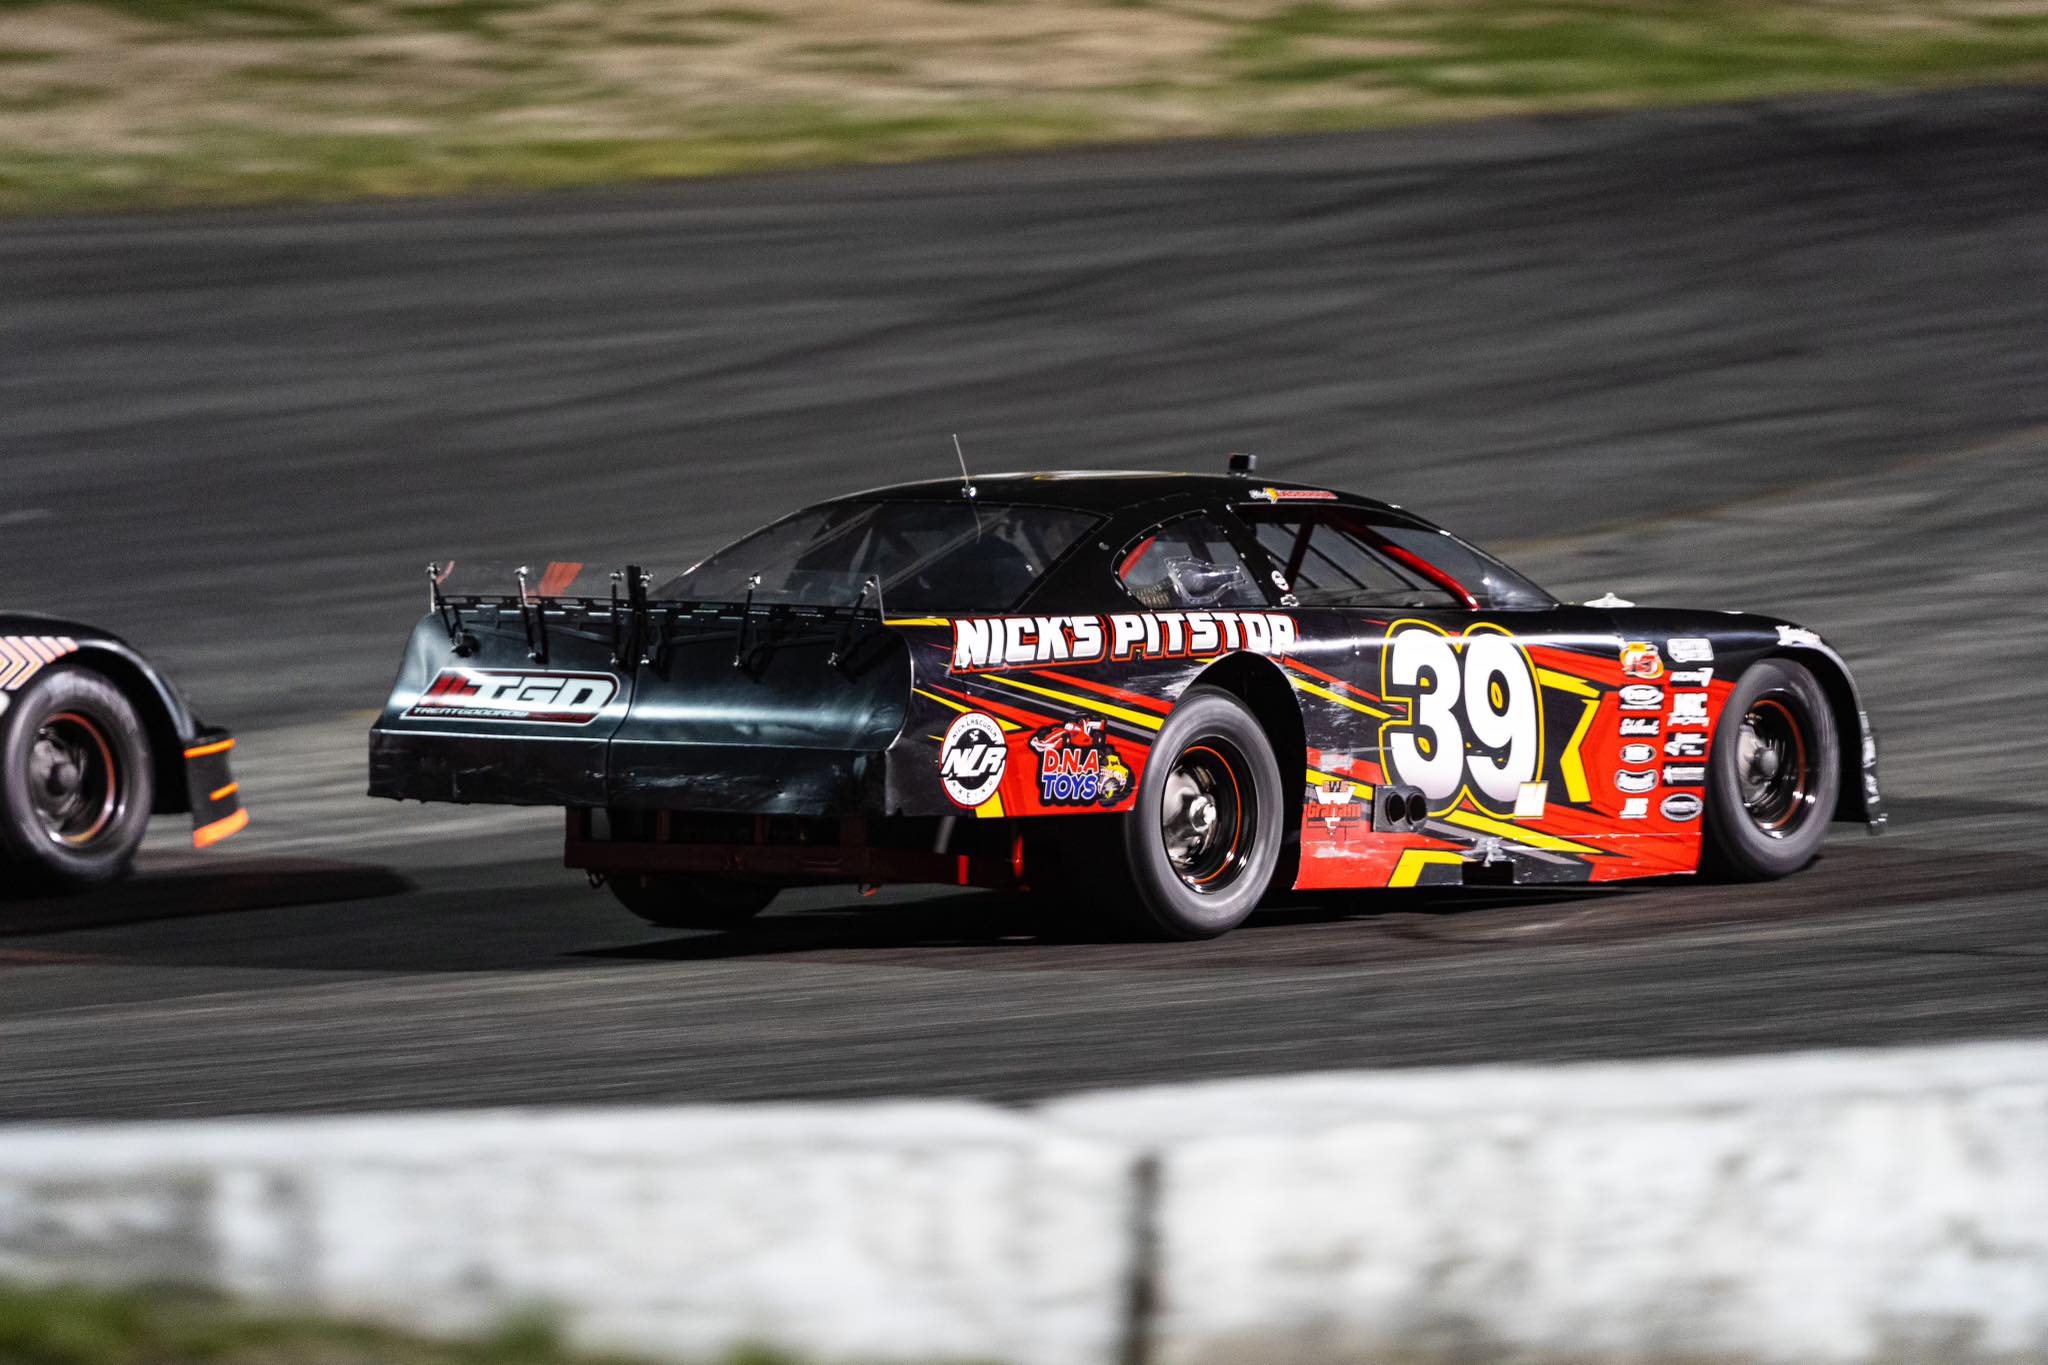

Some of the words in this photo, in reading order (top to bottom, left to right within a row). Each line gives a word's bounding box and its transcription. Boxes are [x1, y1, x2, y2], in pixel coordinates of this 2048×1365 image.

[953, 614, 1102, 668] NICK'S
[1113, 611, 1296, 656] PITSTOP
[470, 675, 612, 707] TGD
[1390, 628, 1537, 802] 39
[940, 743, 1008, 777] NLR
[1041, 774, 1098, 799] TOYS
